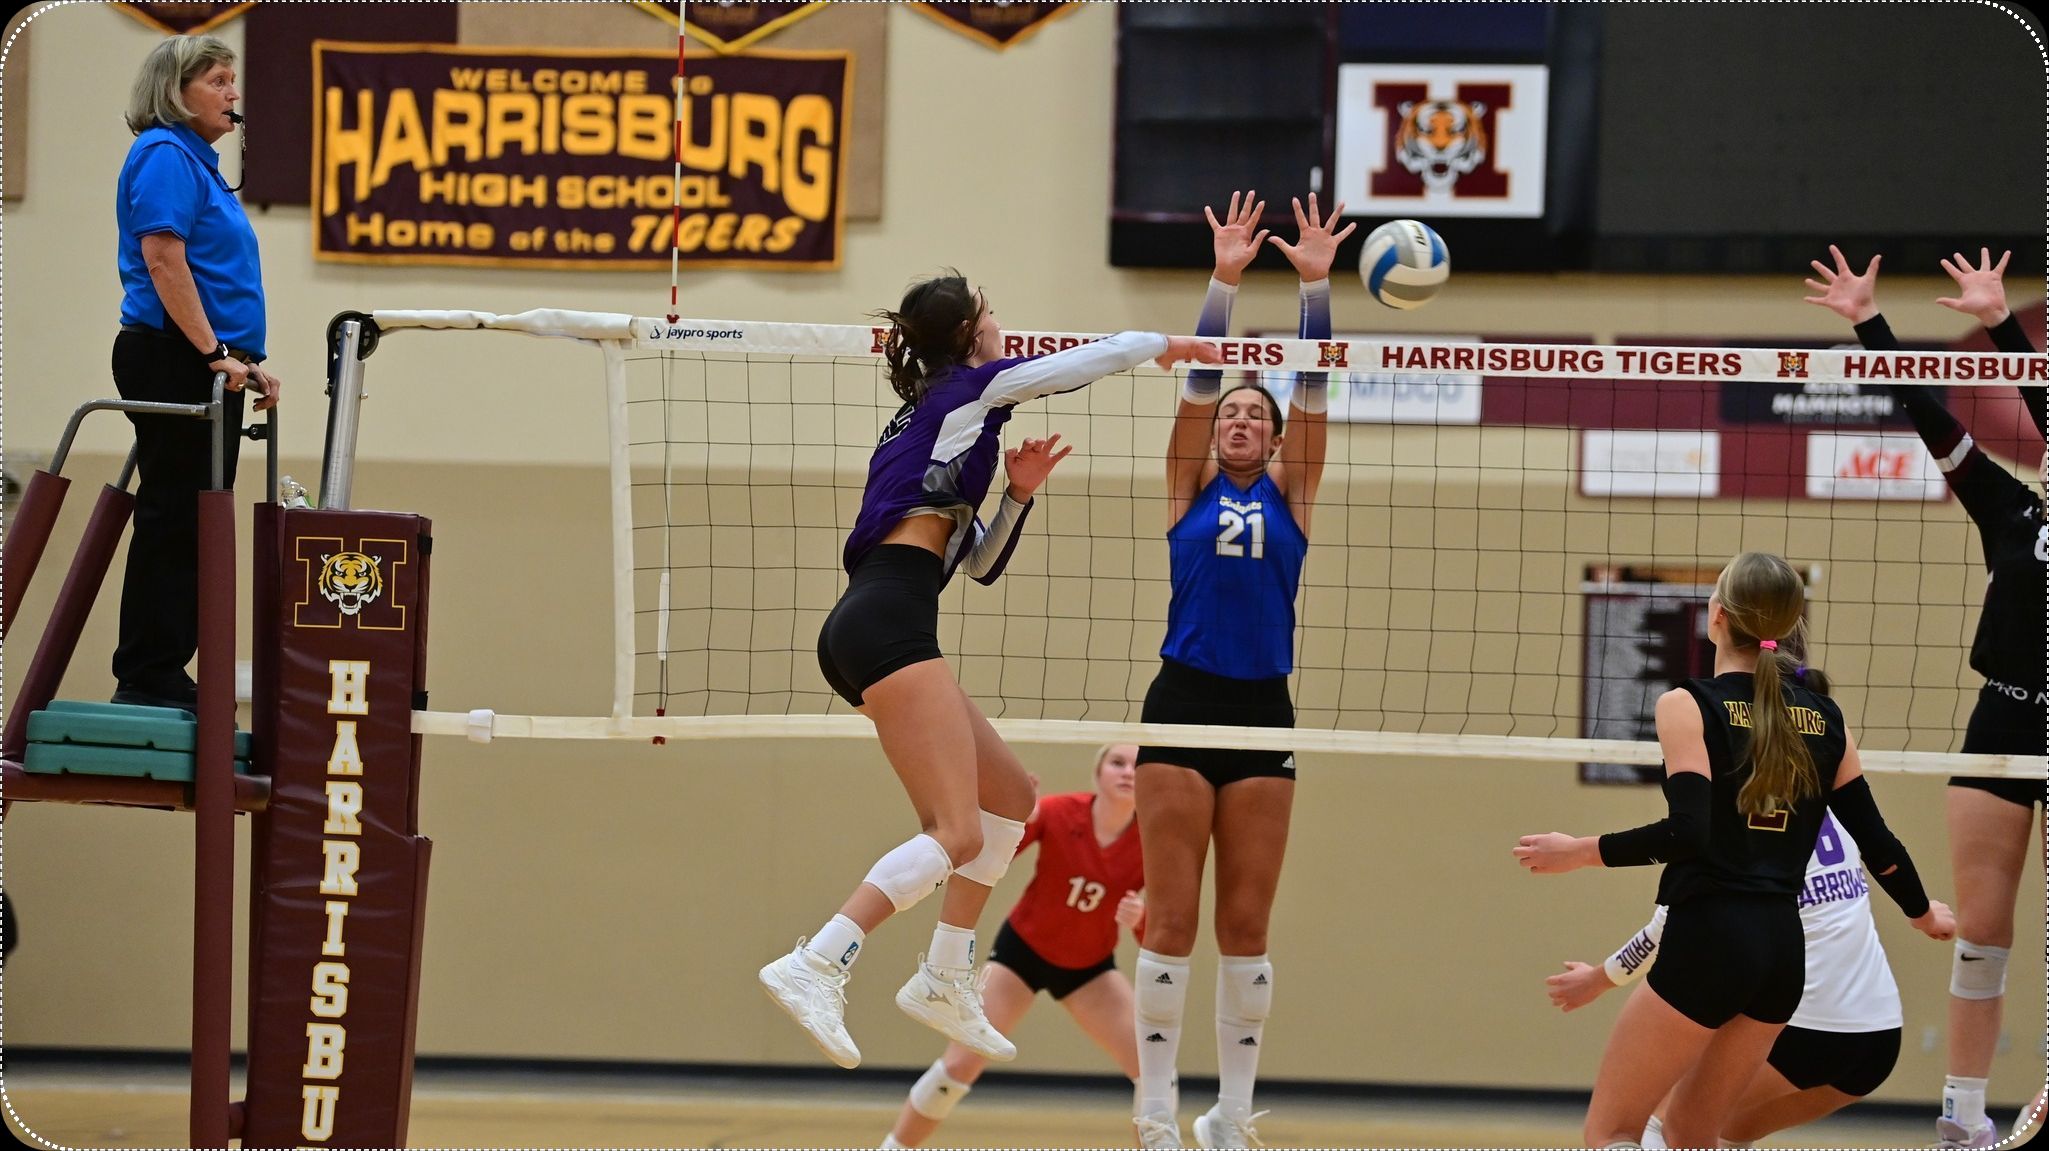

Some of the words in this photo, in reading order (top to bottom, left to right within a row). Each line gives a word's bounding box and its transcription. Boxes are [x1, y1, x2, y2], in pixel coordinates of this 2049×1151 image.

[450, 66, 648, 94] WELCOME
[323, 86, 834, 222] HARRISBURG
[419, 170, 548, 208] HIGH
[556, 175, 731, 209] SCHOOL
[346, 211, 495, 250] Home
[508, 226, 548, 251] of
[554, 227, 616, 253] the
[628, 212, 806, 253] TIGERS
[666, 326, 704, 339] jaypro
[706, 328, 744, 340] sports
[1184, 341, 1284, 366] ERS
[1382, 346, 1603, 372] HARRISBURG
[1616, 350, 1743, 376] TIGERS
[1839, 450, 1914, 479] ACE
[1216, 510, 1264, 559] 21
[1723, 701, 1825, 735] HAURG
[296, 660, 371, 1149] HARRISBU
[1066, 875, 1107, 913] 13
[1615, 929, 1656, 976] PRIDE
